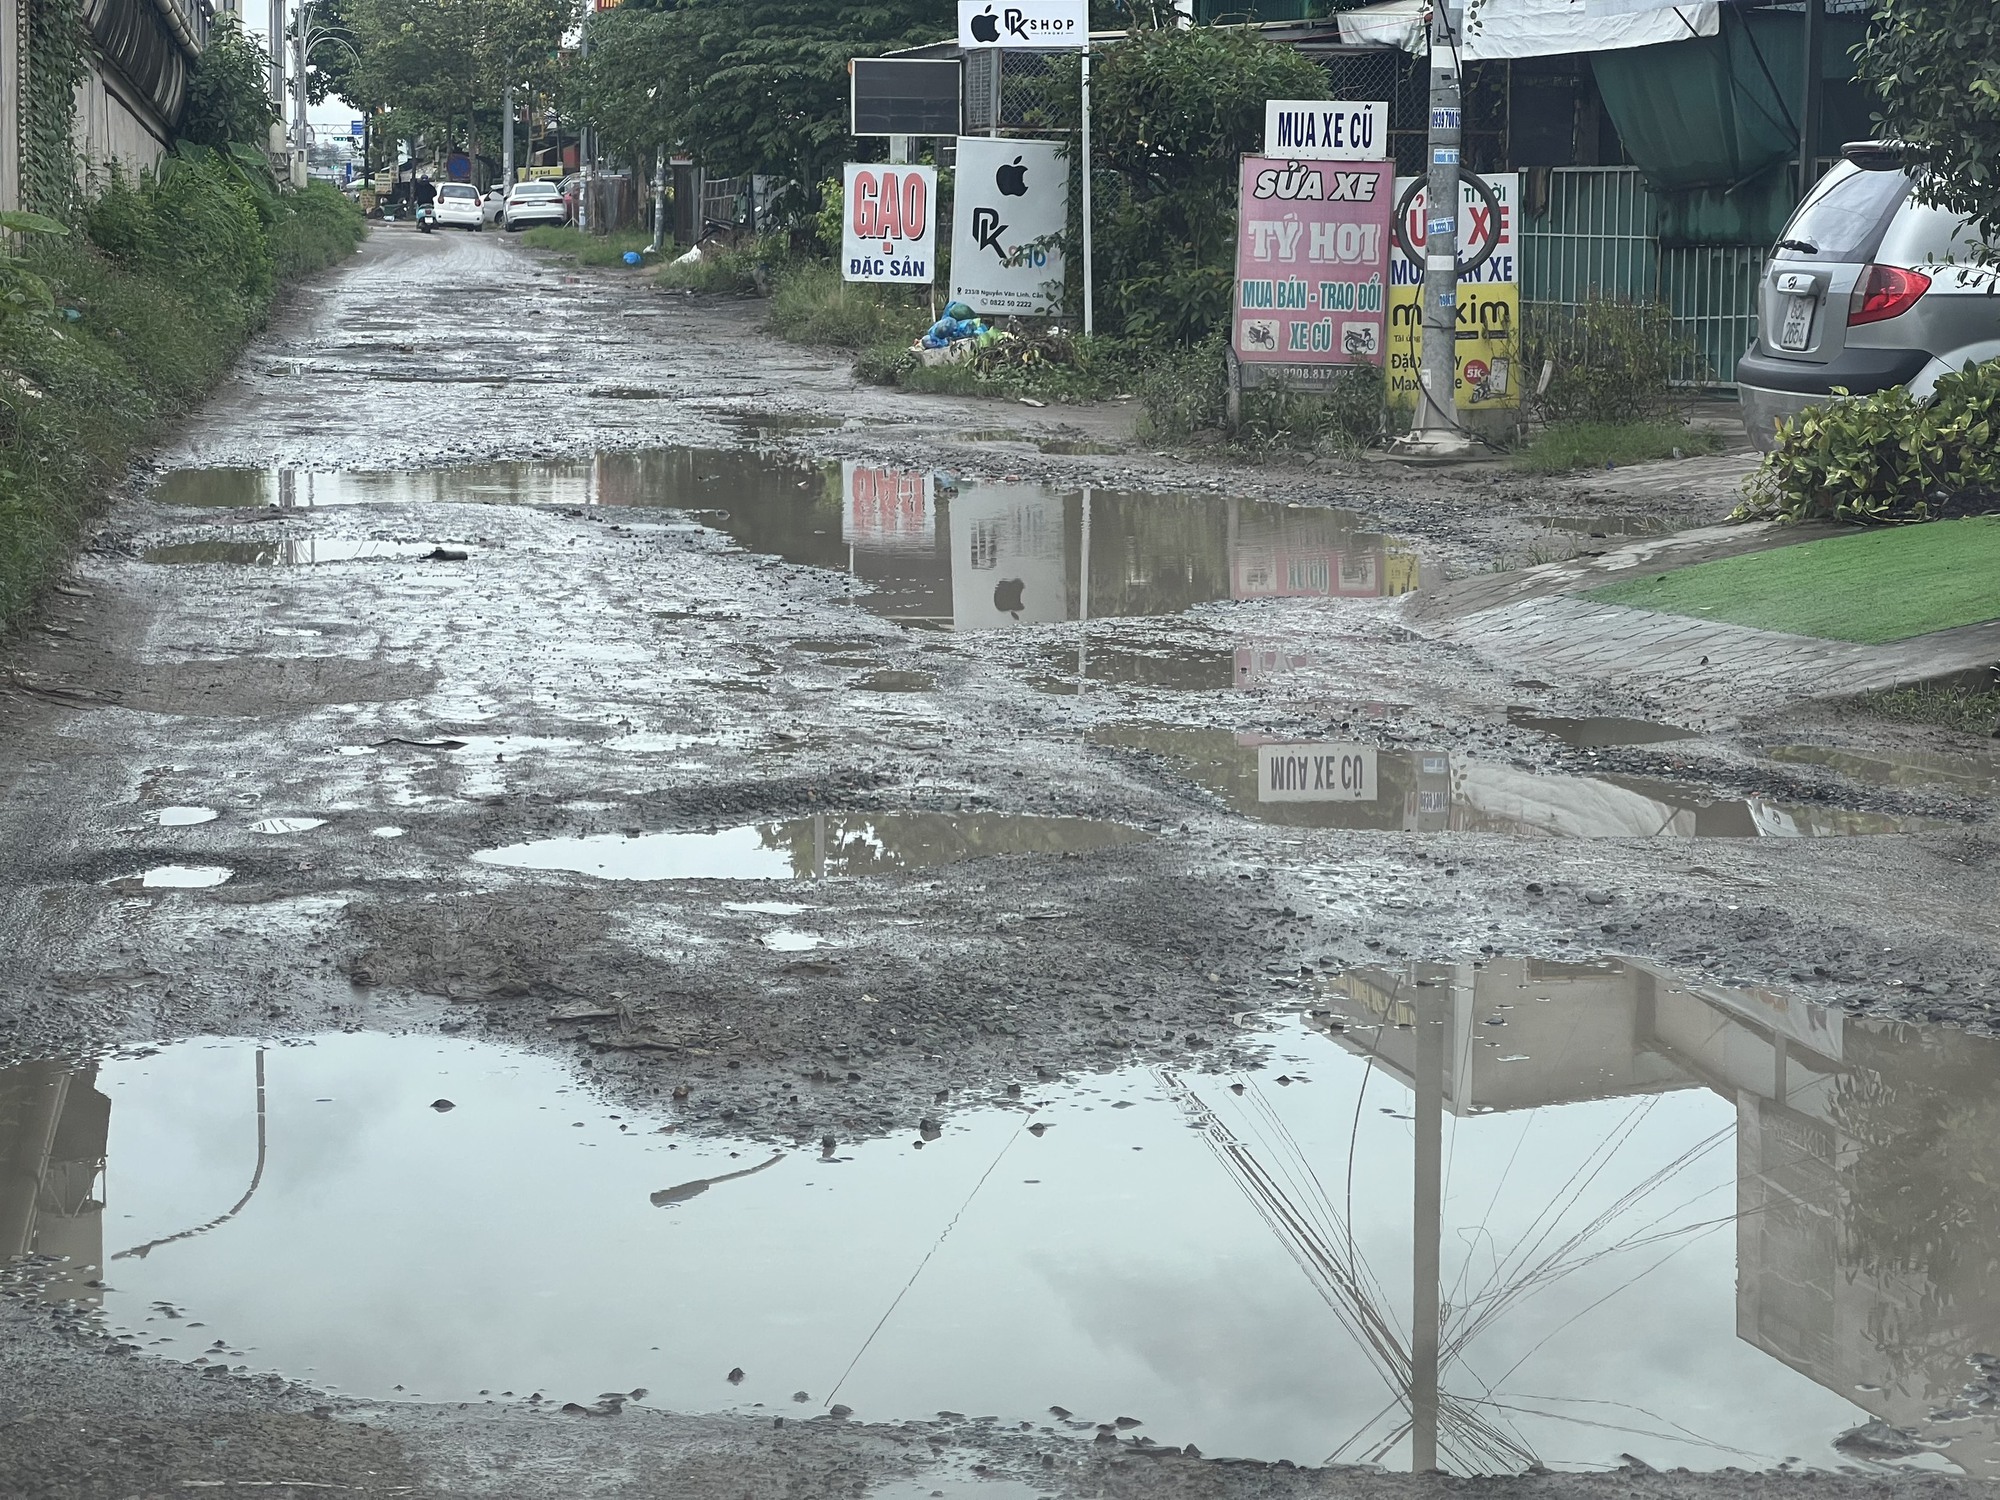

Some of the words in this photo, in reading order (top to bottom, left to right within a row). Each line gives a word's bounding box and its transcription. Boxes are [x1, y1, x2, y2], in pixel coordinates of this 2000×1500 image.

[1030, 20, 1074, 30] SHOP
[1278, 112, 1316, 148] MUA
[1321, 112, 1344, 148] XE
[1350, 104, 1373, 149] CŨ
[1253, 161, 1324, 201] SỬA
[1328, 172, 1380, 202] XE
[853, 171, 927, 255] GẠO
[850, 256, 884, 279] ĐẶC
[890, 255, 925, 277] SẢN
[1391, 258, 1424, 285] MU
[1488, 256, 1513, 282] XE
[1242, 281, 1273, 308] MUA
[1277, 275, 1307, 309] BÁN
[1320, 282, 1354, 311] TRAO
[1357, 273, 1382, 311] ĐỔI
[1393, 294, 1510, 327] mxim
[1290, 323, 1308, 350] XE
[1312, 318, 1333, 351] CŨ
